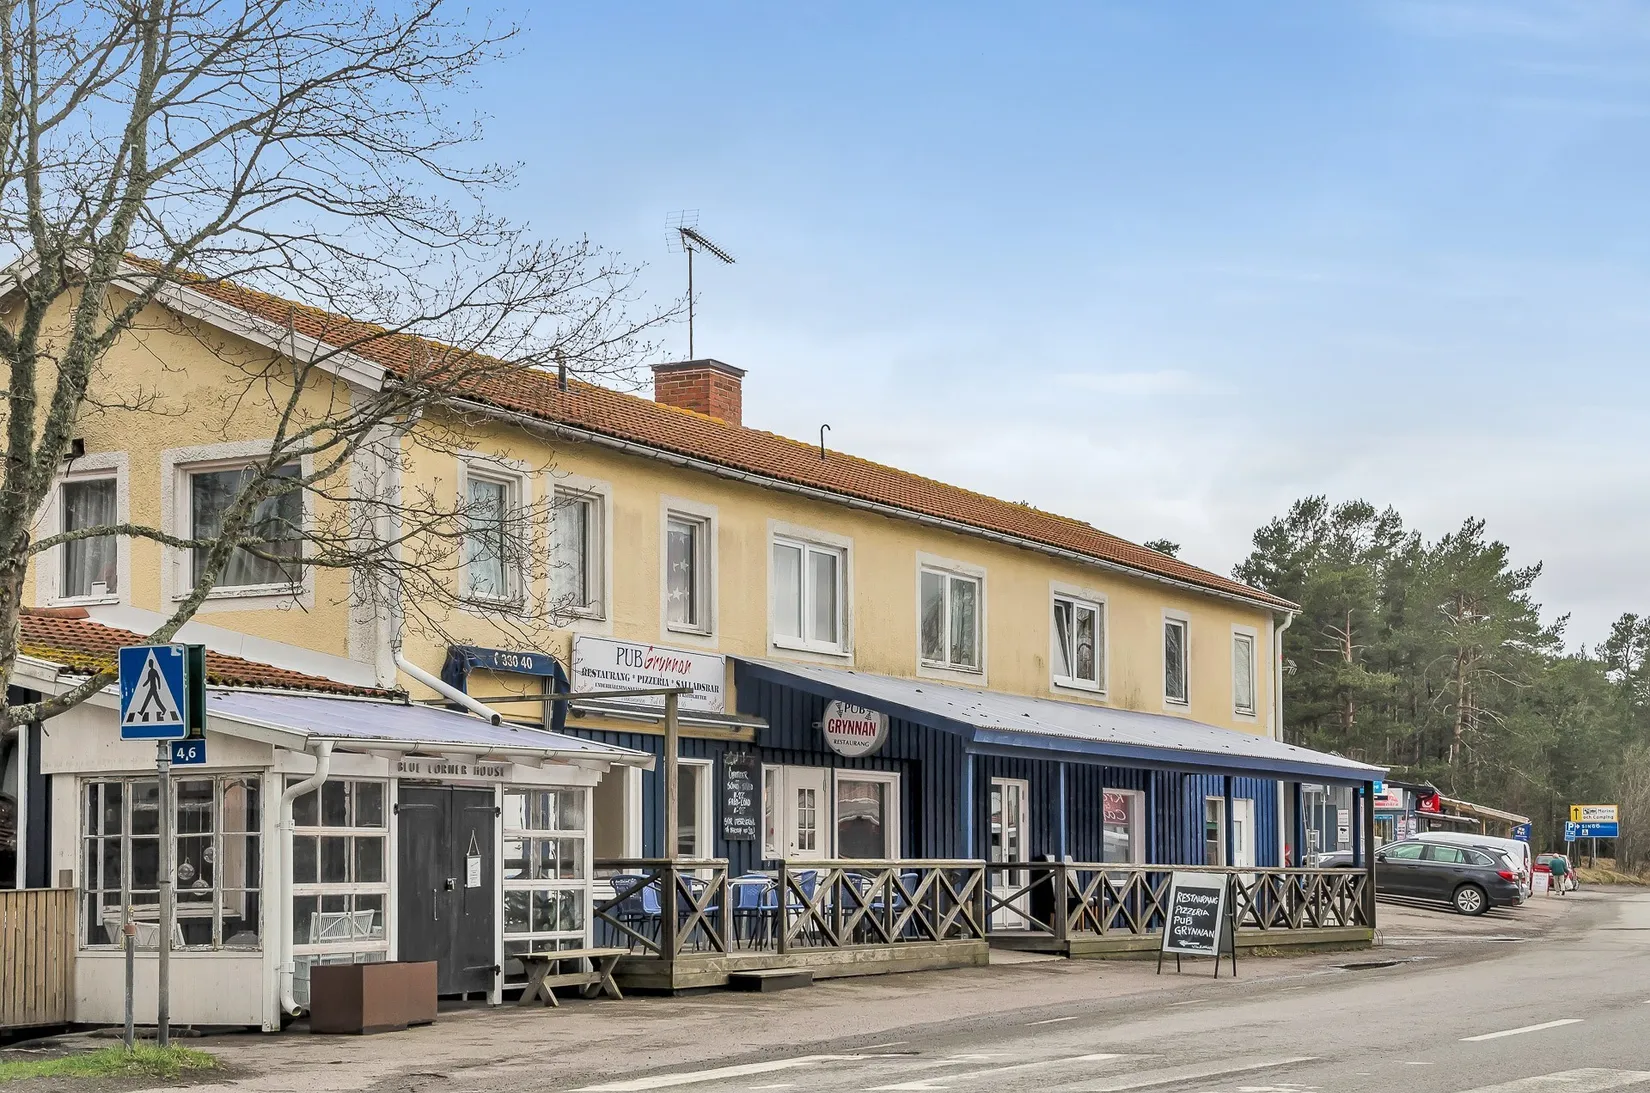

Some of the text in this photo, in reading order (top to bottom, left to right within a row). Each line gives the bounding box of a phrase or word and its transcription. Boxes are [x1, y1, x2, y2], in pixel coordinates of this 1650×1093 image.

[501, 654, 533, 670] 330 40
[616, 646, 643, 668] PUB
[581, 667, 631, 682] RESTAURANG
[637, 675, 669, 687] PIZZERIA
[828, 718, 876, 737] GRYNNAN
[833, 739, 870, 748] RESTAURANG
[176, 746, 196, 761] 4,6
[397, 762, 420, 774] BLUE
[473, 765, 505, 777] HOUSE
[1568, 822, 1574, 830] P
[1174, 905, 1210, 917] PIZZERIA
[1173, 915, 1193, 926] PUB
[1174, 925, 1215, 938] GRYNNAN
